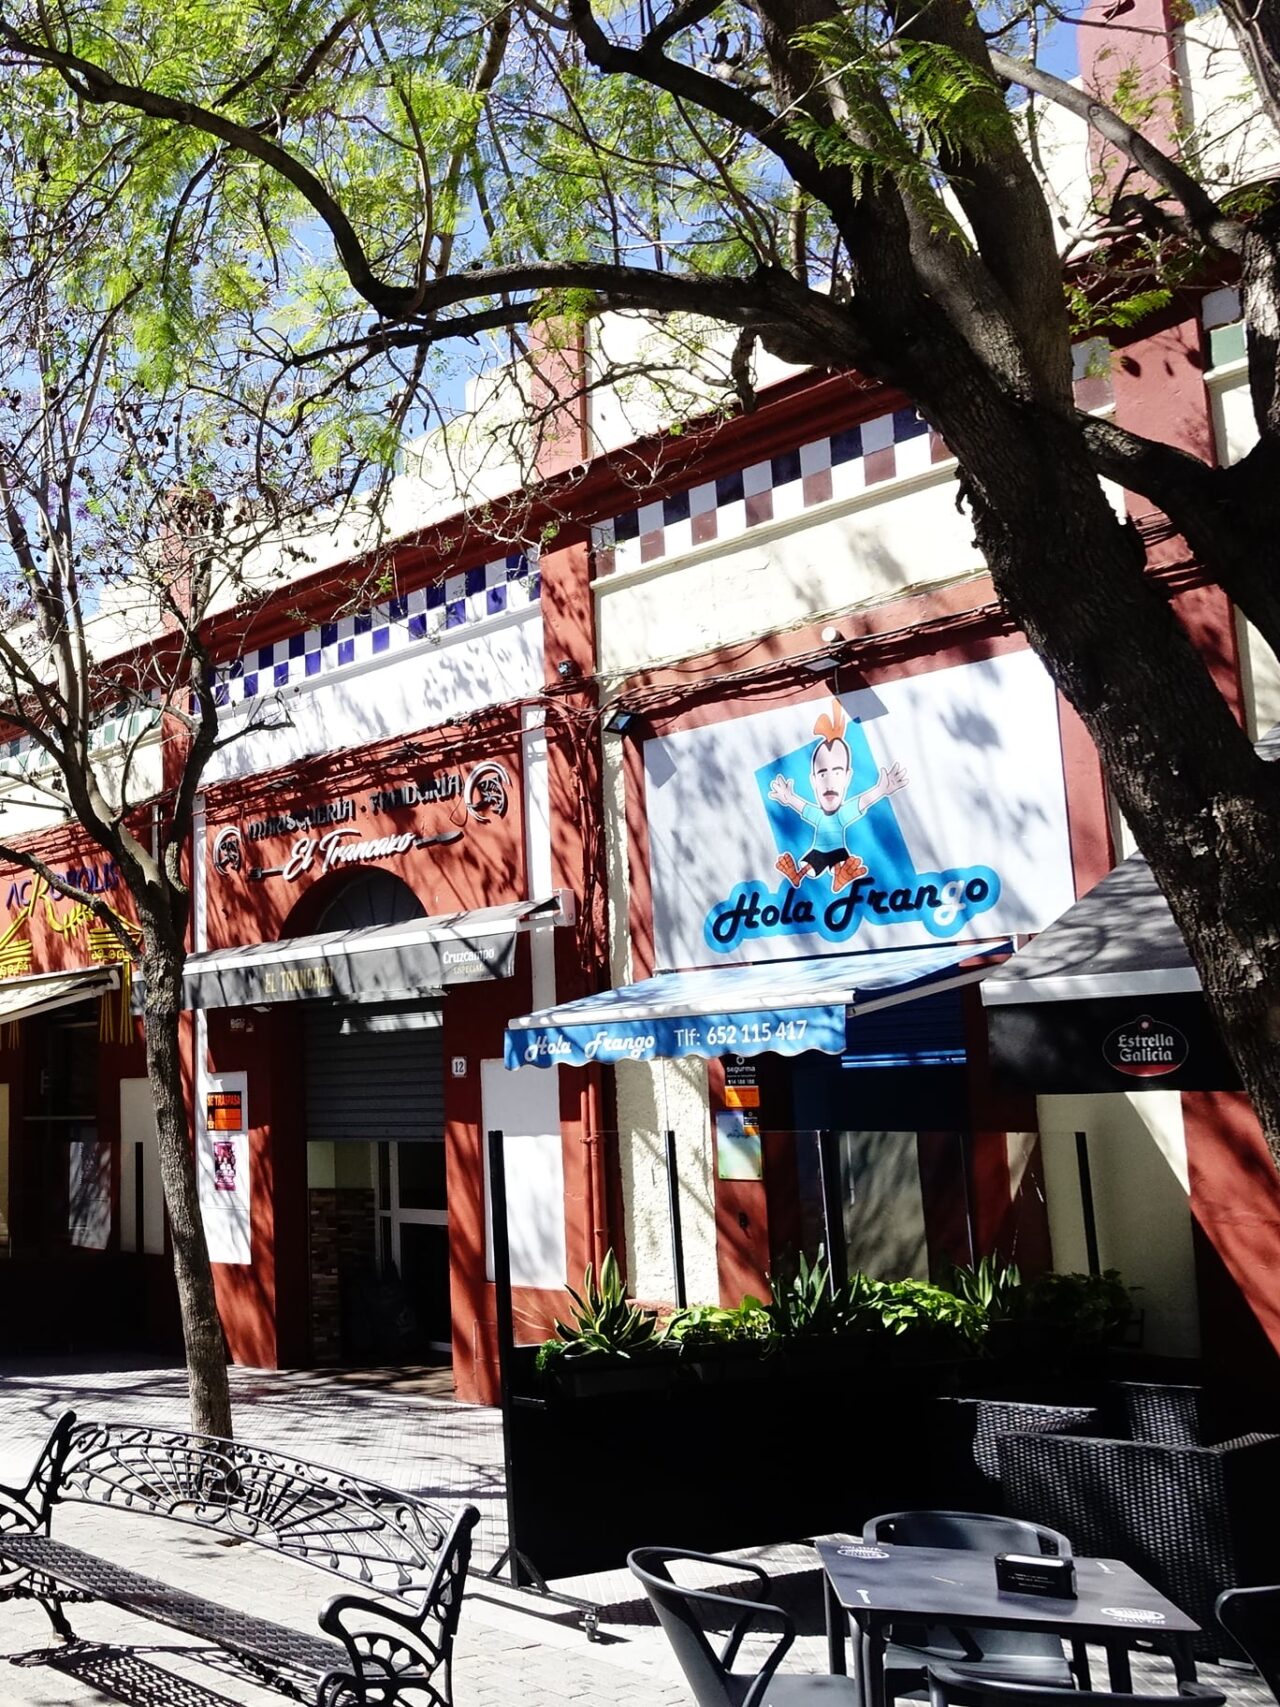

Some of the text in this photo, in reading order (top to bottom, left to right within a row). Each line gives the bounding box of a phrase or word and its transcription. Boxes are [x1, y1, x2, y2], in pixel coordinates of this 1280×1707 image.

[282, 828, 417, 881] El Trancazo
[712, 877, 989, 944] Hola Frango
[442, 947, 495, 966] Cruzcampo
[264, 973, 277, 994] EL
[524, 1020, 807, 1062] Hola Frango Tlf: 652 115 417
[1117, 1033, 1174, 1048] Estrella
[1120, 1048, 1173, 1062] Galicia
[455, 1061, 464, 1073] 12
